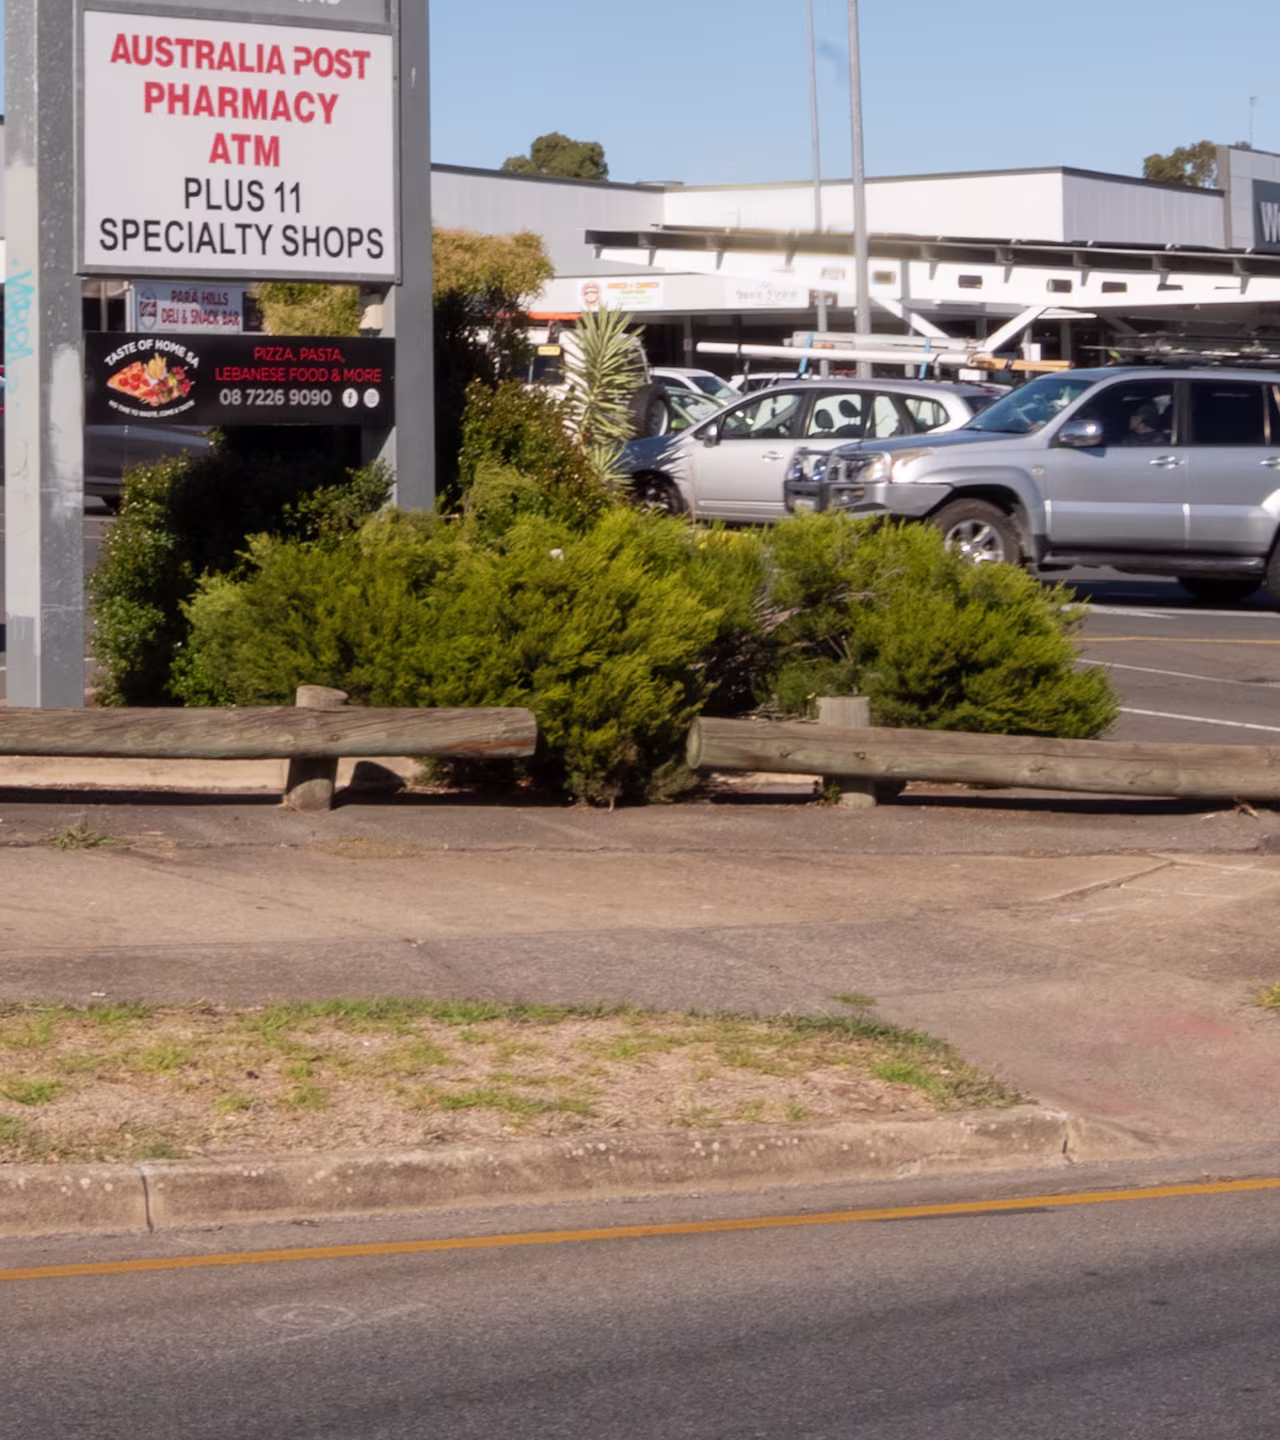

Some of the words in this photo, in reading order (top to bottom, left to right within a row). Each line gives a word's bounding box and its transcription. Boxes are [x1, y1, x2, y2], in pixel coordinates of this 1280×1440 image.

[111, 34, 285, 76] AUSTRALIA
[293, 46, 370, 79] POST
[144, 82, 339, 124] PHARMACY
[208, 132, 281, 167] ATM
[185, 177, 264, 213] PLUS
[274, 181, 301, 214] 11
[99, 218, 273, 256] SPECIALTY
[281, 225, 384, 260] SHOPS
[171, 290, 198, 304] PARA
[202, 291, 229, 306] HILLS
[162, 308, 178, 323] DELI
[191, 309, 219, 325] SNACK
[222, 310, 240, 326] BAR
[104, 341, 138, 366] TASTE
[137, 339, 153, 351] OF
[155, 339, 186, 358] HOME
[185, 351, 200, 368] SA
[254, 347, 296, 363] PIZZA,
[300, 347, 345, 363] PASTA,
[215, 367, 286, 382] LEBANESE
[289, 368, 328, 382] FOOD
[331, 369, 341, 382] &
[343, 369, 383, 383] MORE
[220, 389, 241, 405] 08
[246, 389, 285, 405] 7226
[289, 389, 332, 406] 9090
